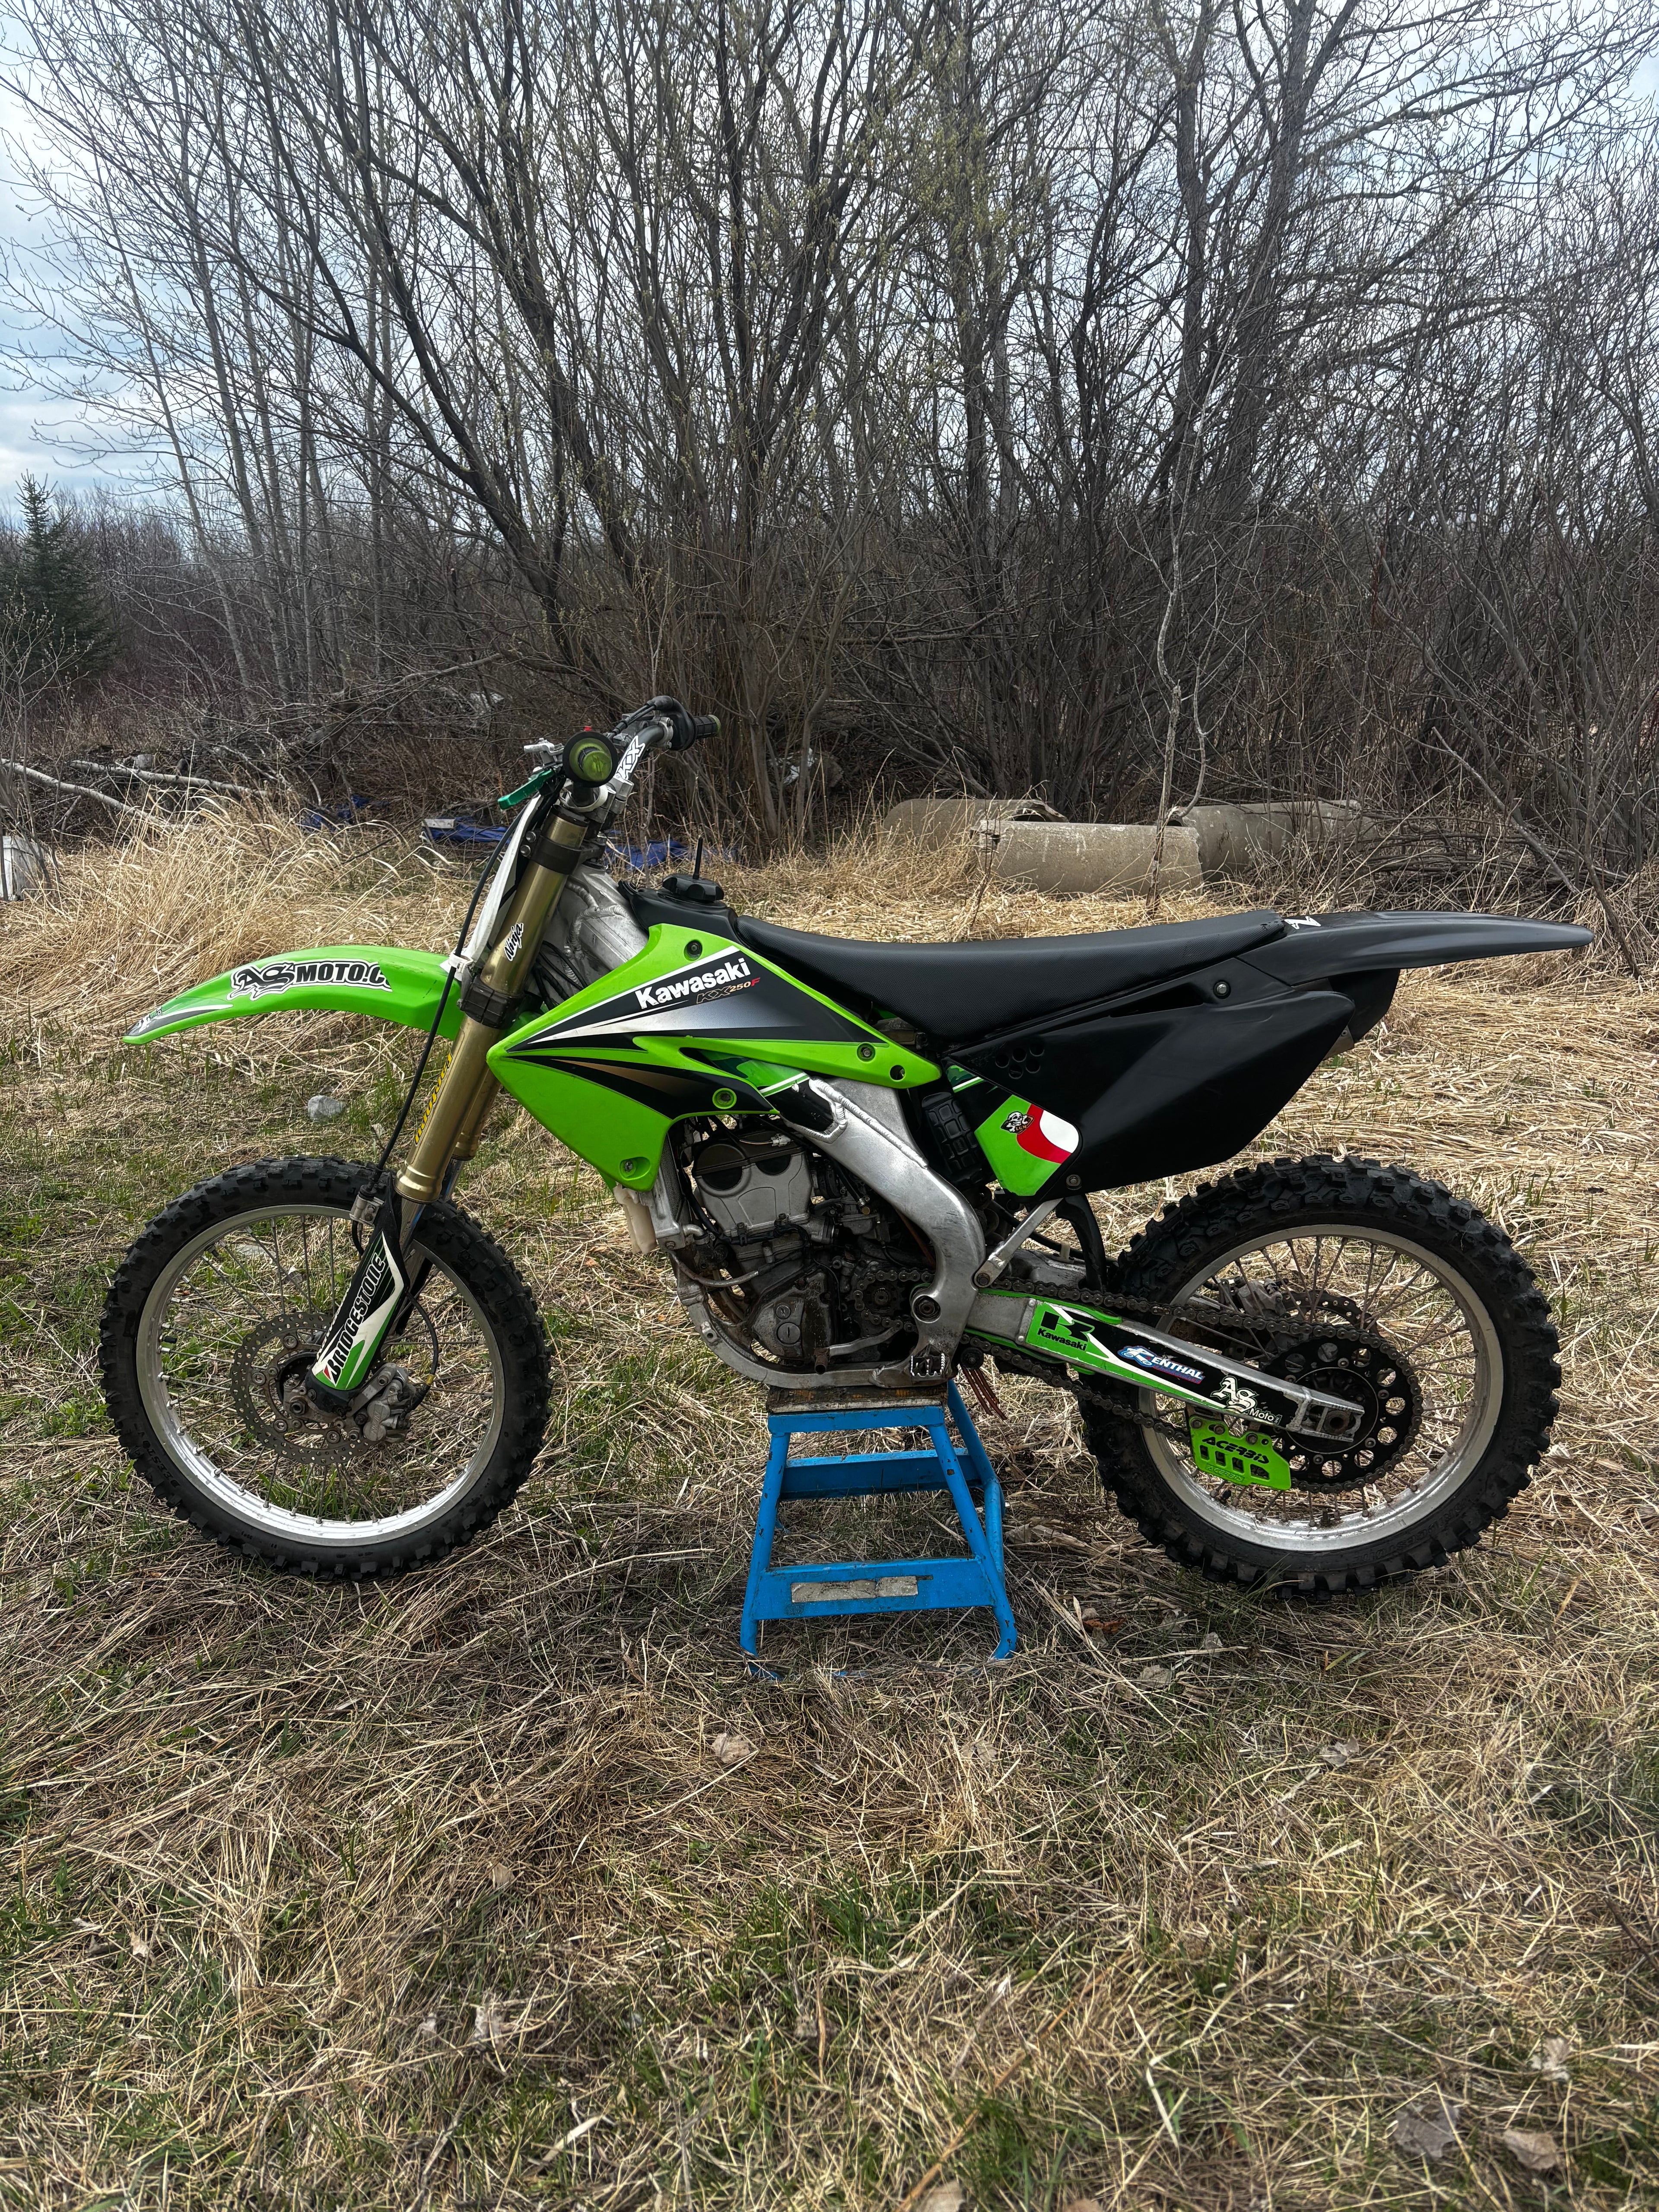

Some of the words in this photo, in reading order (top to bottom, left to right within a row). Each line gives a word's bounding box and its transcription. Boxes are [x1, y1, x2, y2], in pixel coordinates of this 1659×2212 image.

[617, 736, 645, 780] KX
[505, 923, 523, 960] Ninja
[635, 957, 751, 1009] Kawasaki
[696, 977, 760, 1004] KX250F
[325, 1254, 385, 1386] BRIDGESTONE
[1037, 1328, 1087, 1351] Kawasaki
[1249, 1408, 1274, 1422] Moto
